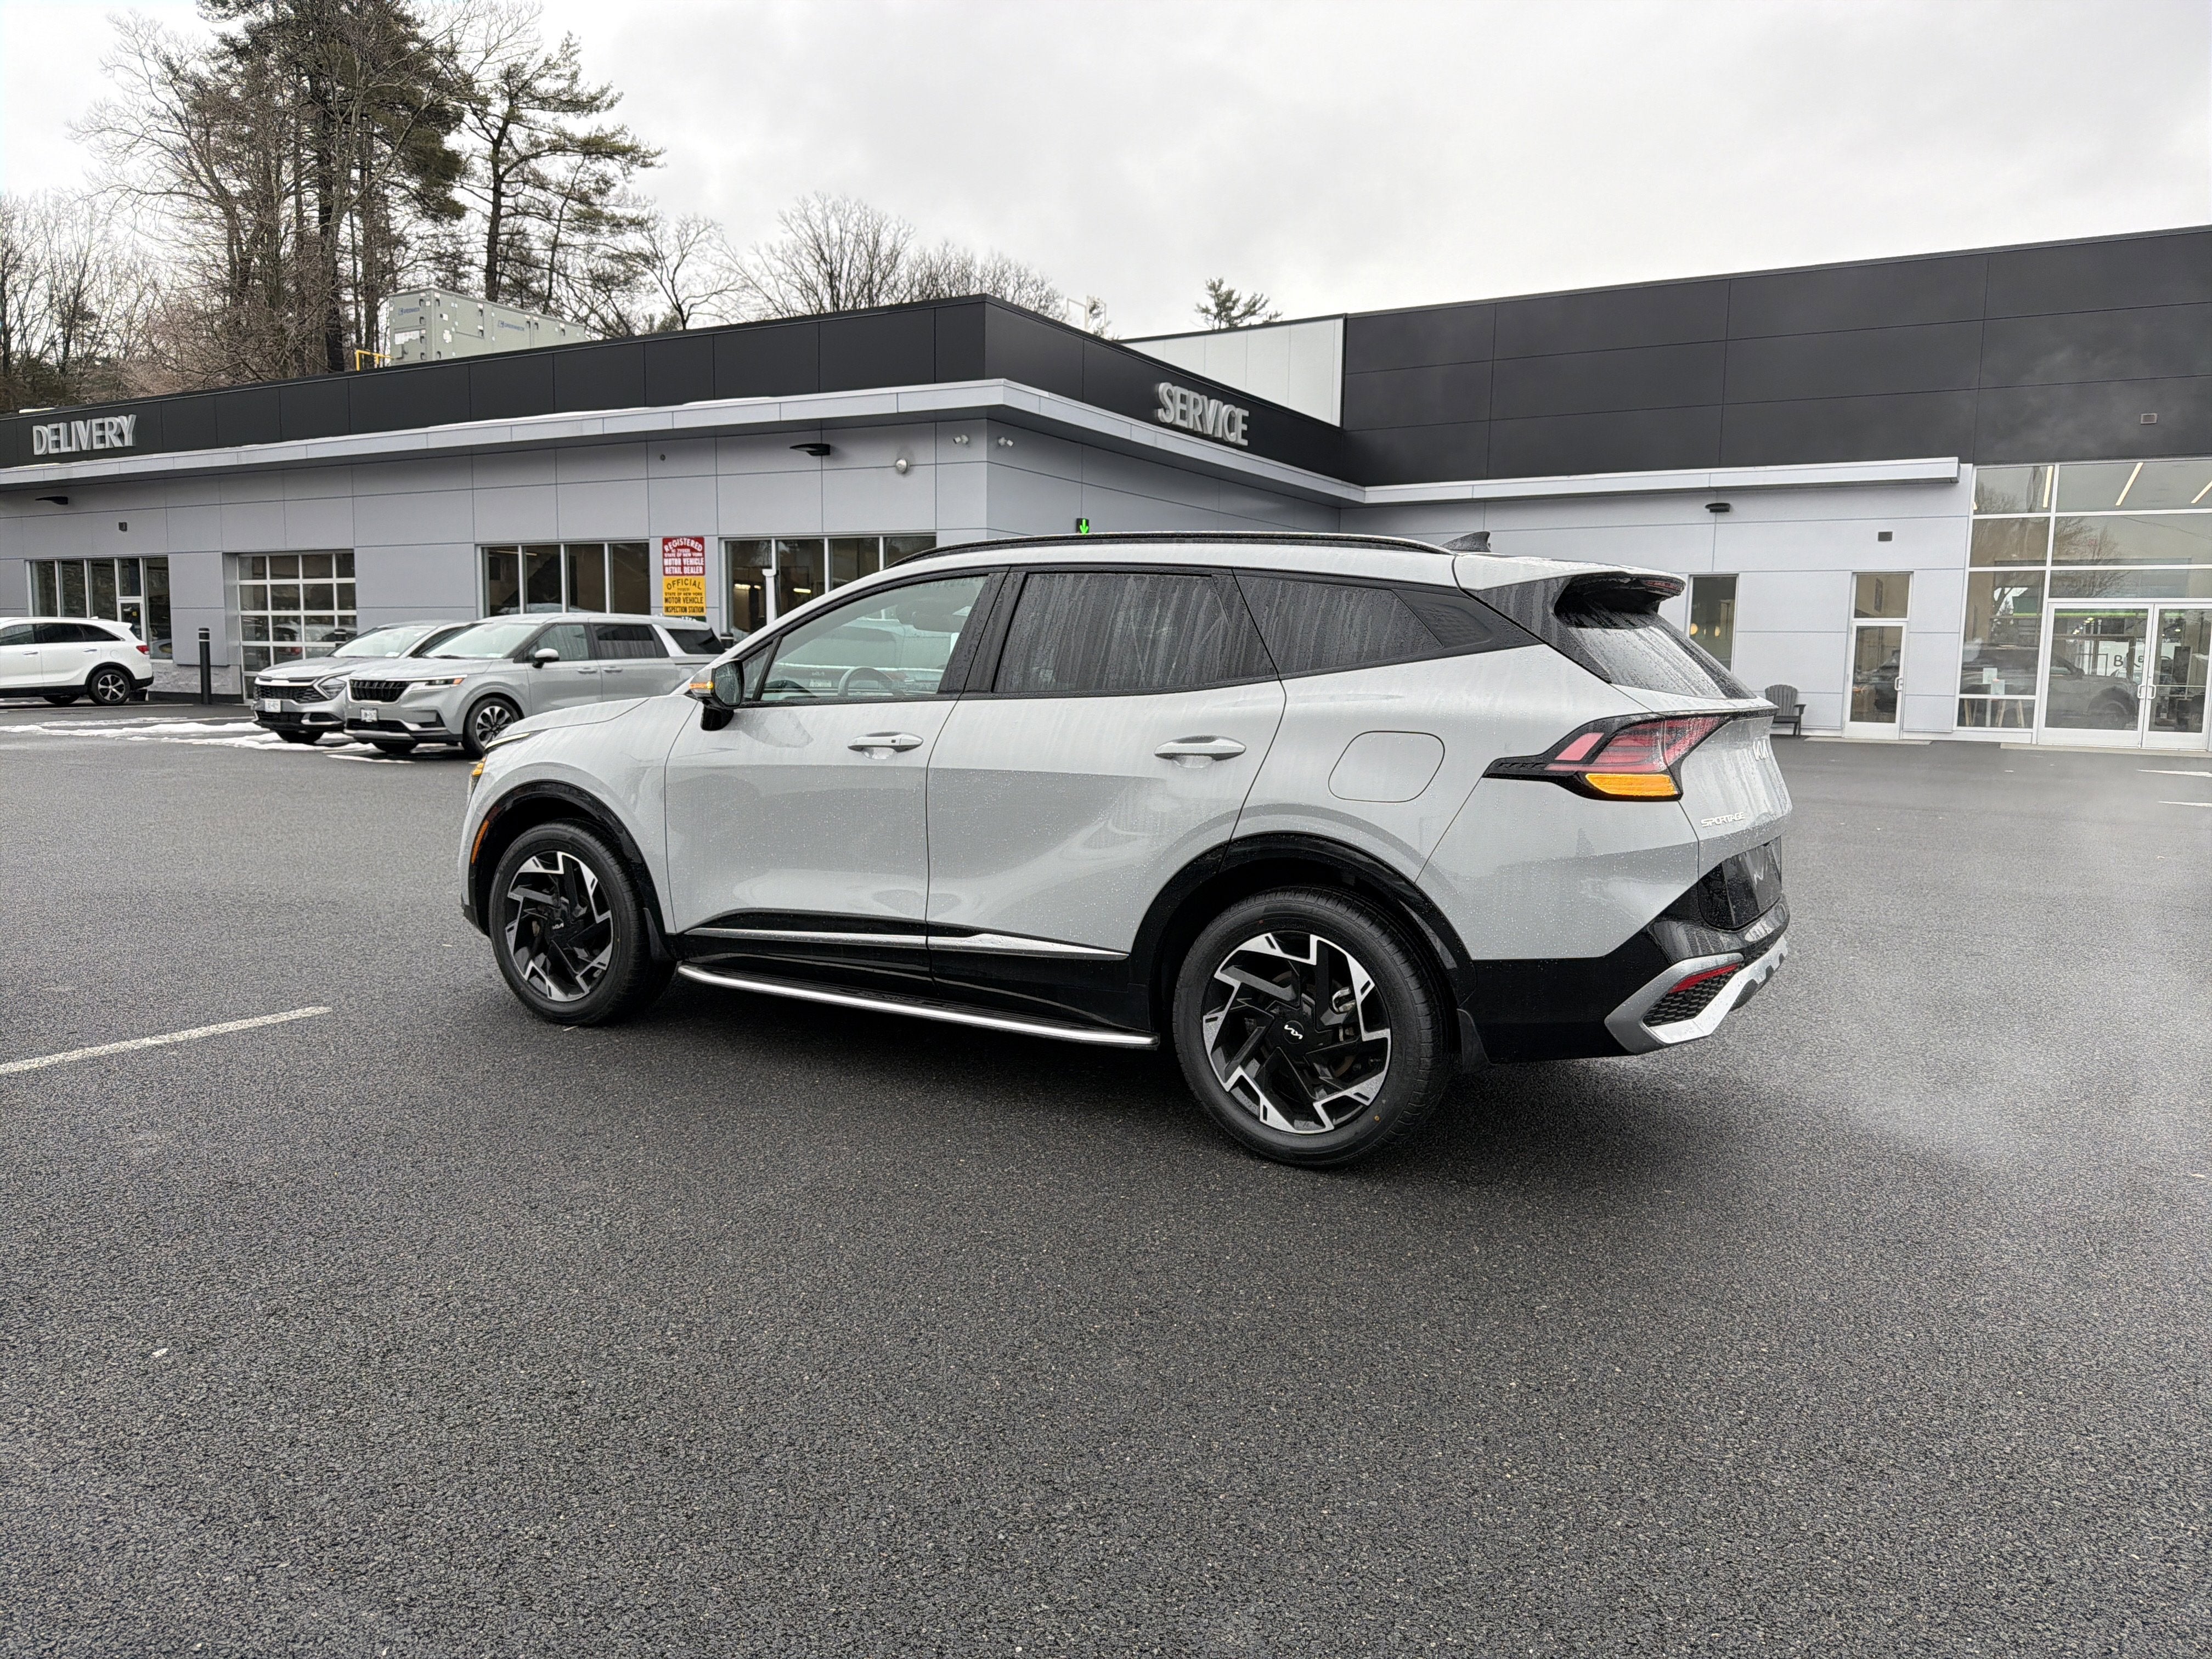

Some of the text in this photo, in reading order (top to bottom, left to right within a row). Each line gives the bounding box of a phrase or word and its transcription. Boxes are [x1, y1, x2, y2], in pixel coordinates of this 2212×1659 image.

[1157, 382, 1249, 446] SERVICE
[32, 414, 137, 455] DELIVERY
[664, 538, 703, 552] REGISTERED
[664, 557, 704, 566] MOTOR VEHICLE
[665, 566, 703, 574] RETAIL DEALER
[666, 578, 702, 590] OFFICIAL
[1701, 811, 1745, 827] SPORTAGE
